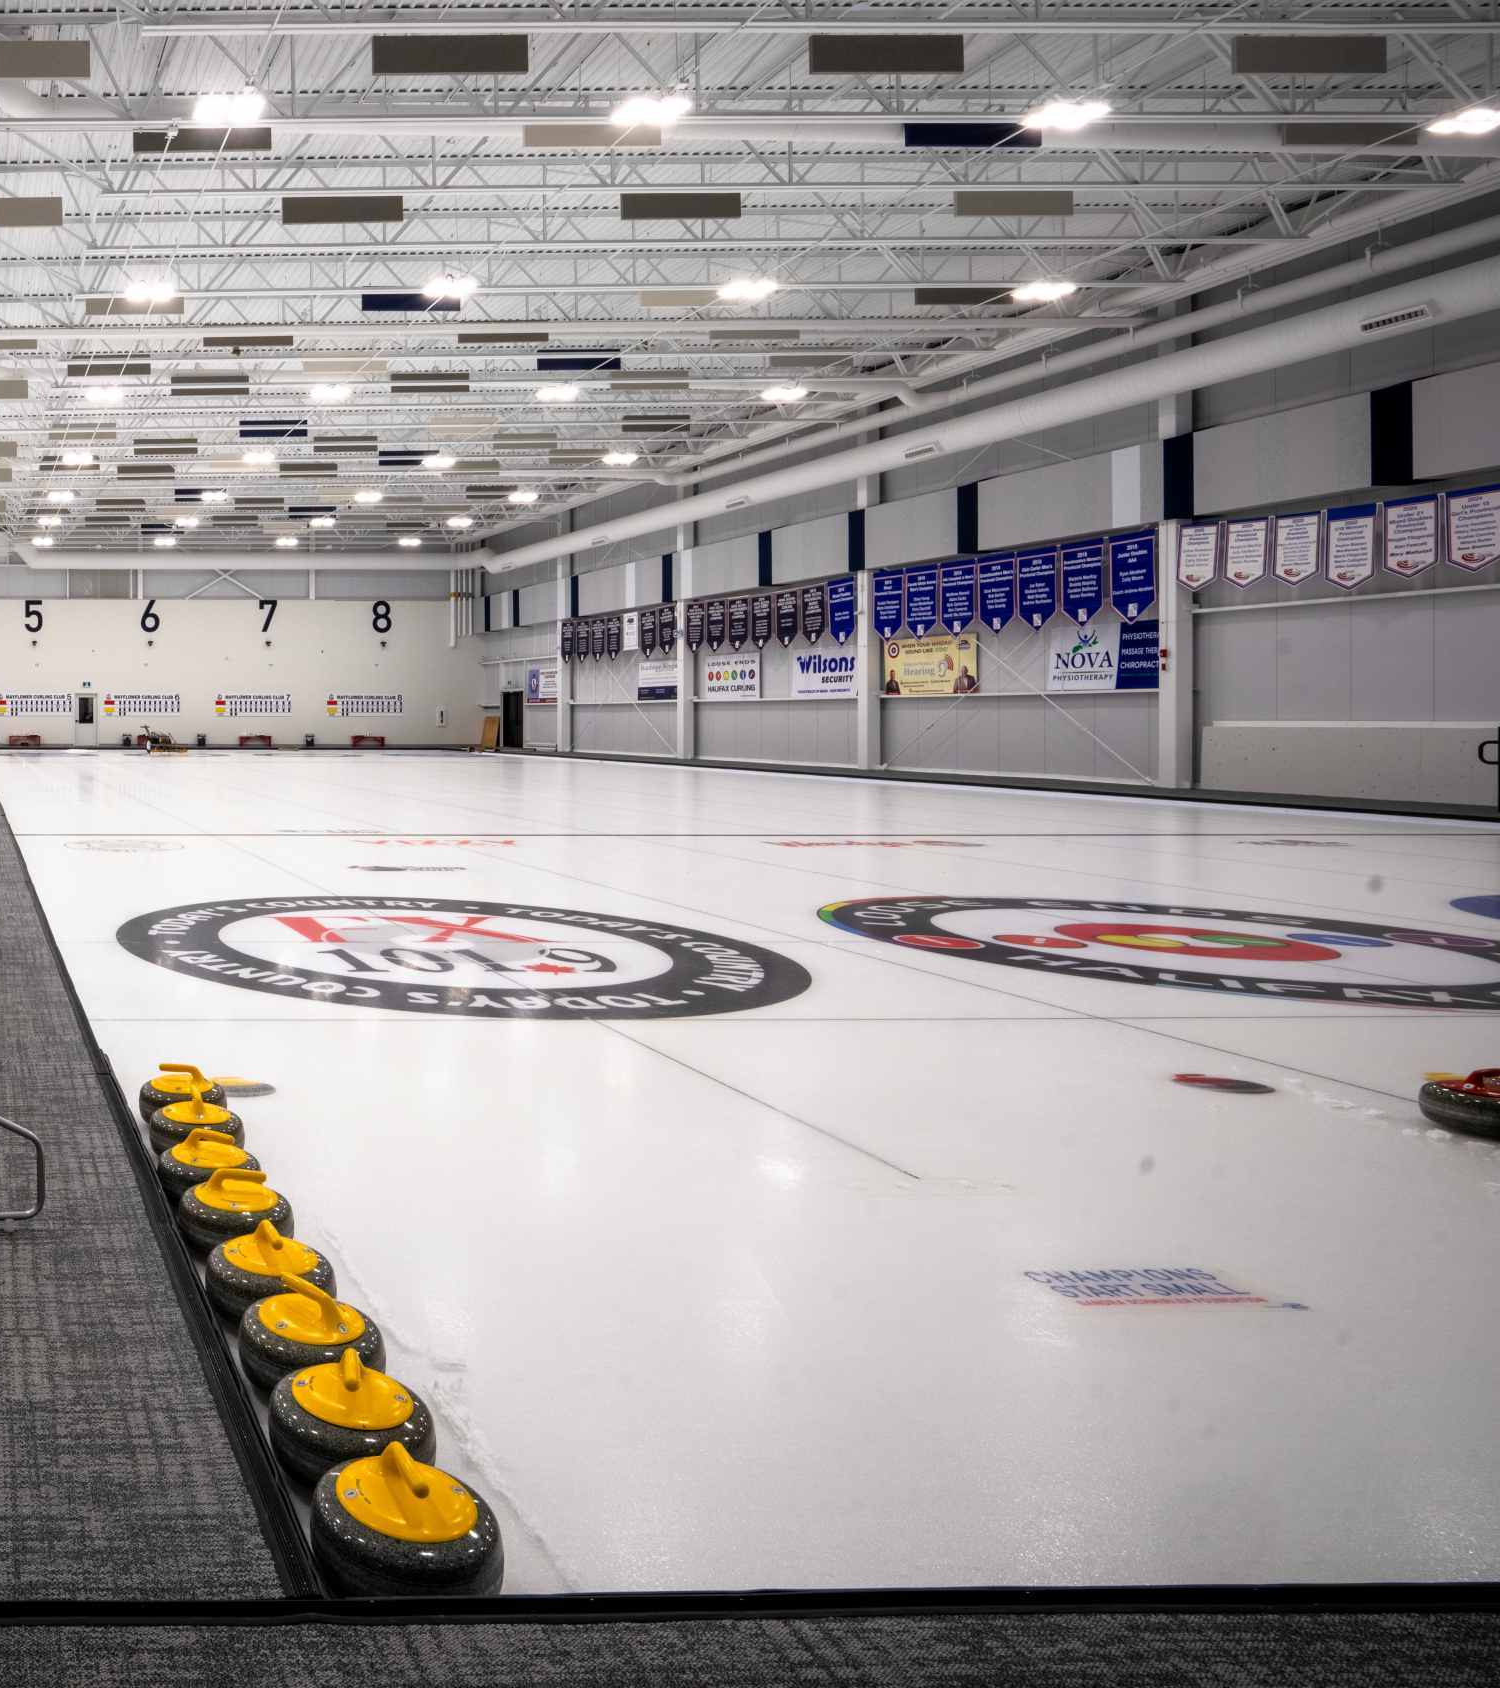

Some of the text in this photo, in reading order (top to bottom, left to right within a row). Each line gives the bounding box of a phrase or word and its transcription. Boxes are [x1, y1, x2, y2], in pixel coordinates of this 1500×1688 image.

[24, 600, 43, 632] 5
[140, 600, 160, 632] 6
[259, 600, 277, 632] 7
[372, 600, 392, 633] 8
[797, 654, 855, 673] Wilsons
[903, 665, 935, 677] Hearing
[1055, 650, 1113, 669] NOVA
[708, 684, 756, 693] HALIFAX CURLING
[821, 675, 853, 683] SECURITY
[149, 899, 439, 936] TODAY'S COUNTRY
[854, 900, 1314, 927] LOOSE ENDS
[262, 916, 557, 943] FX
[502, 907, 765, 992] TODAY'S COUNTRY
[163, 949, 688, 1009] TODAY'S COUNTRY
[1024, 1267, 1217, 1284] CHAMPIONS
[1050, 1282, 1252, 1298] START SMALL
